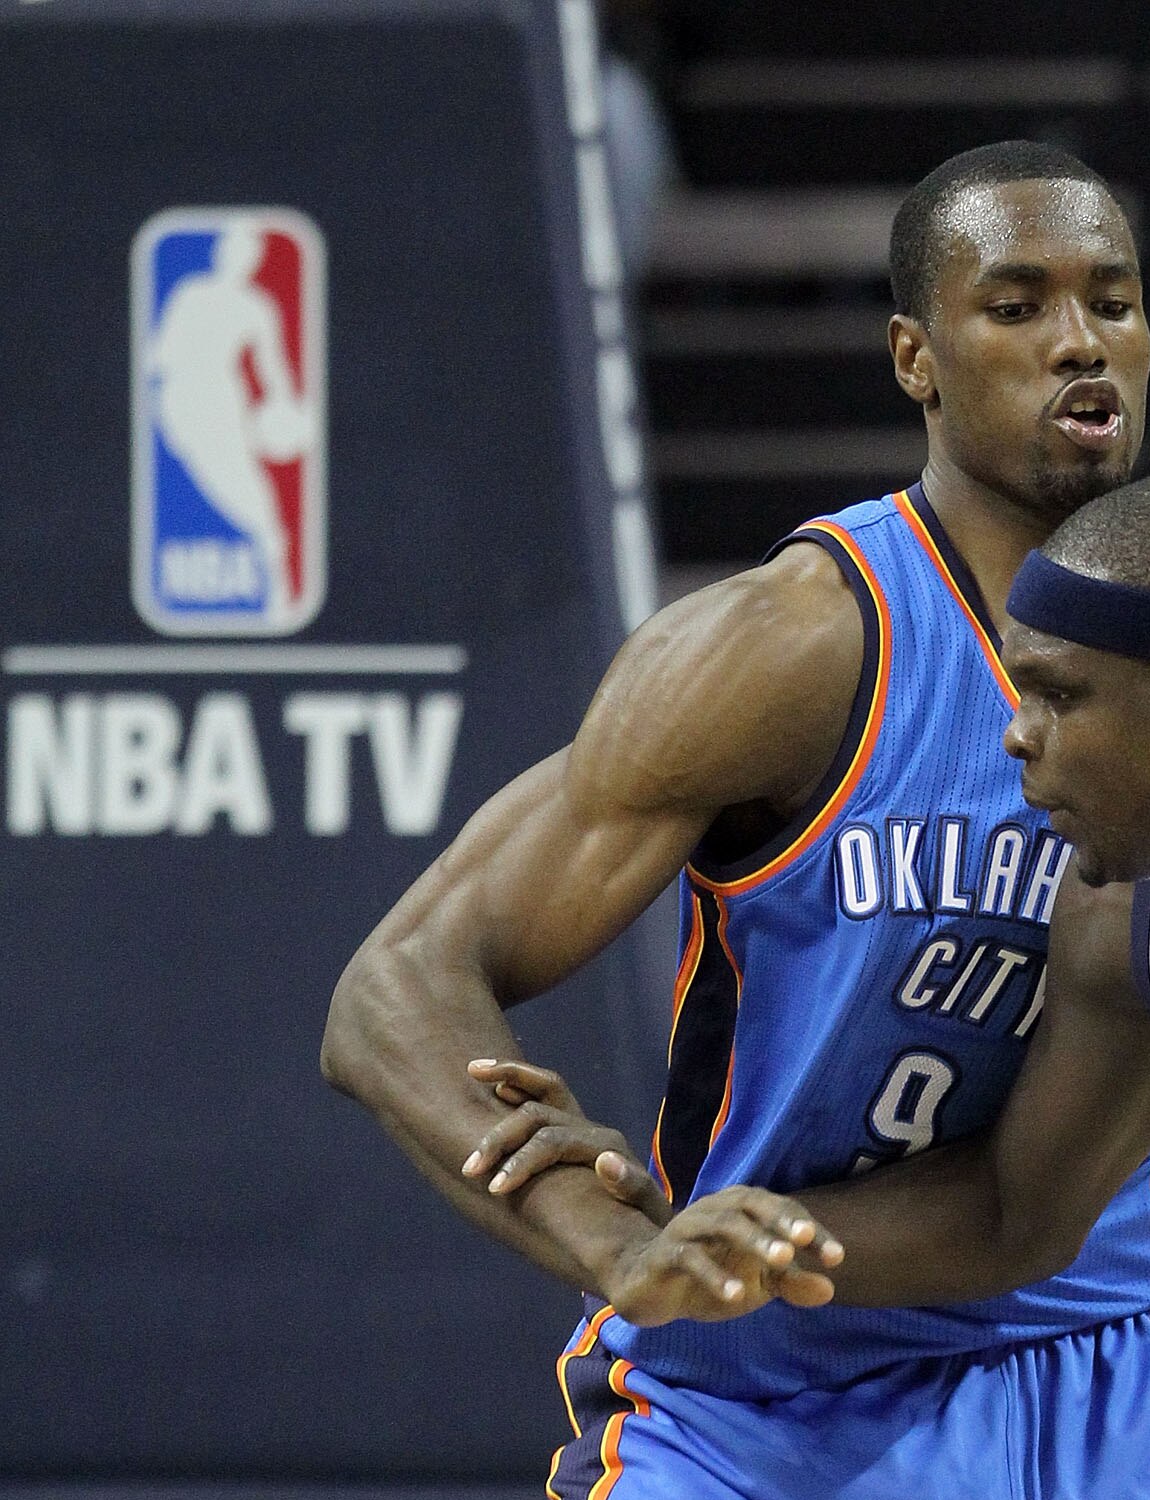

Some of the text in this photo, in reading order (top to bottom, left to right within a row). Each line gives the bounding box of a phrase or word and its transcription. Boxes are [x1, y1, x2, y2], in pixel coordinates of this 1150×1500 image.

[5, 694, 466, 836] NBA TV
[835, 815, 1075, 923] OKLAH
[850, 1048, 959, 1175] 9
